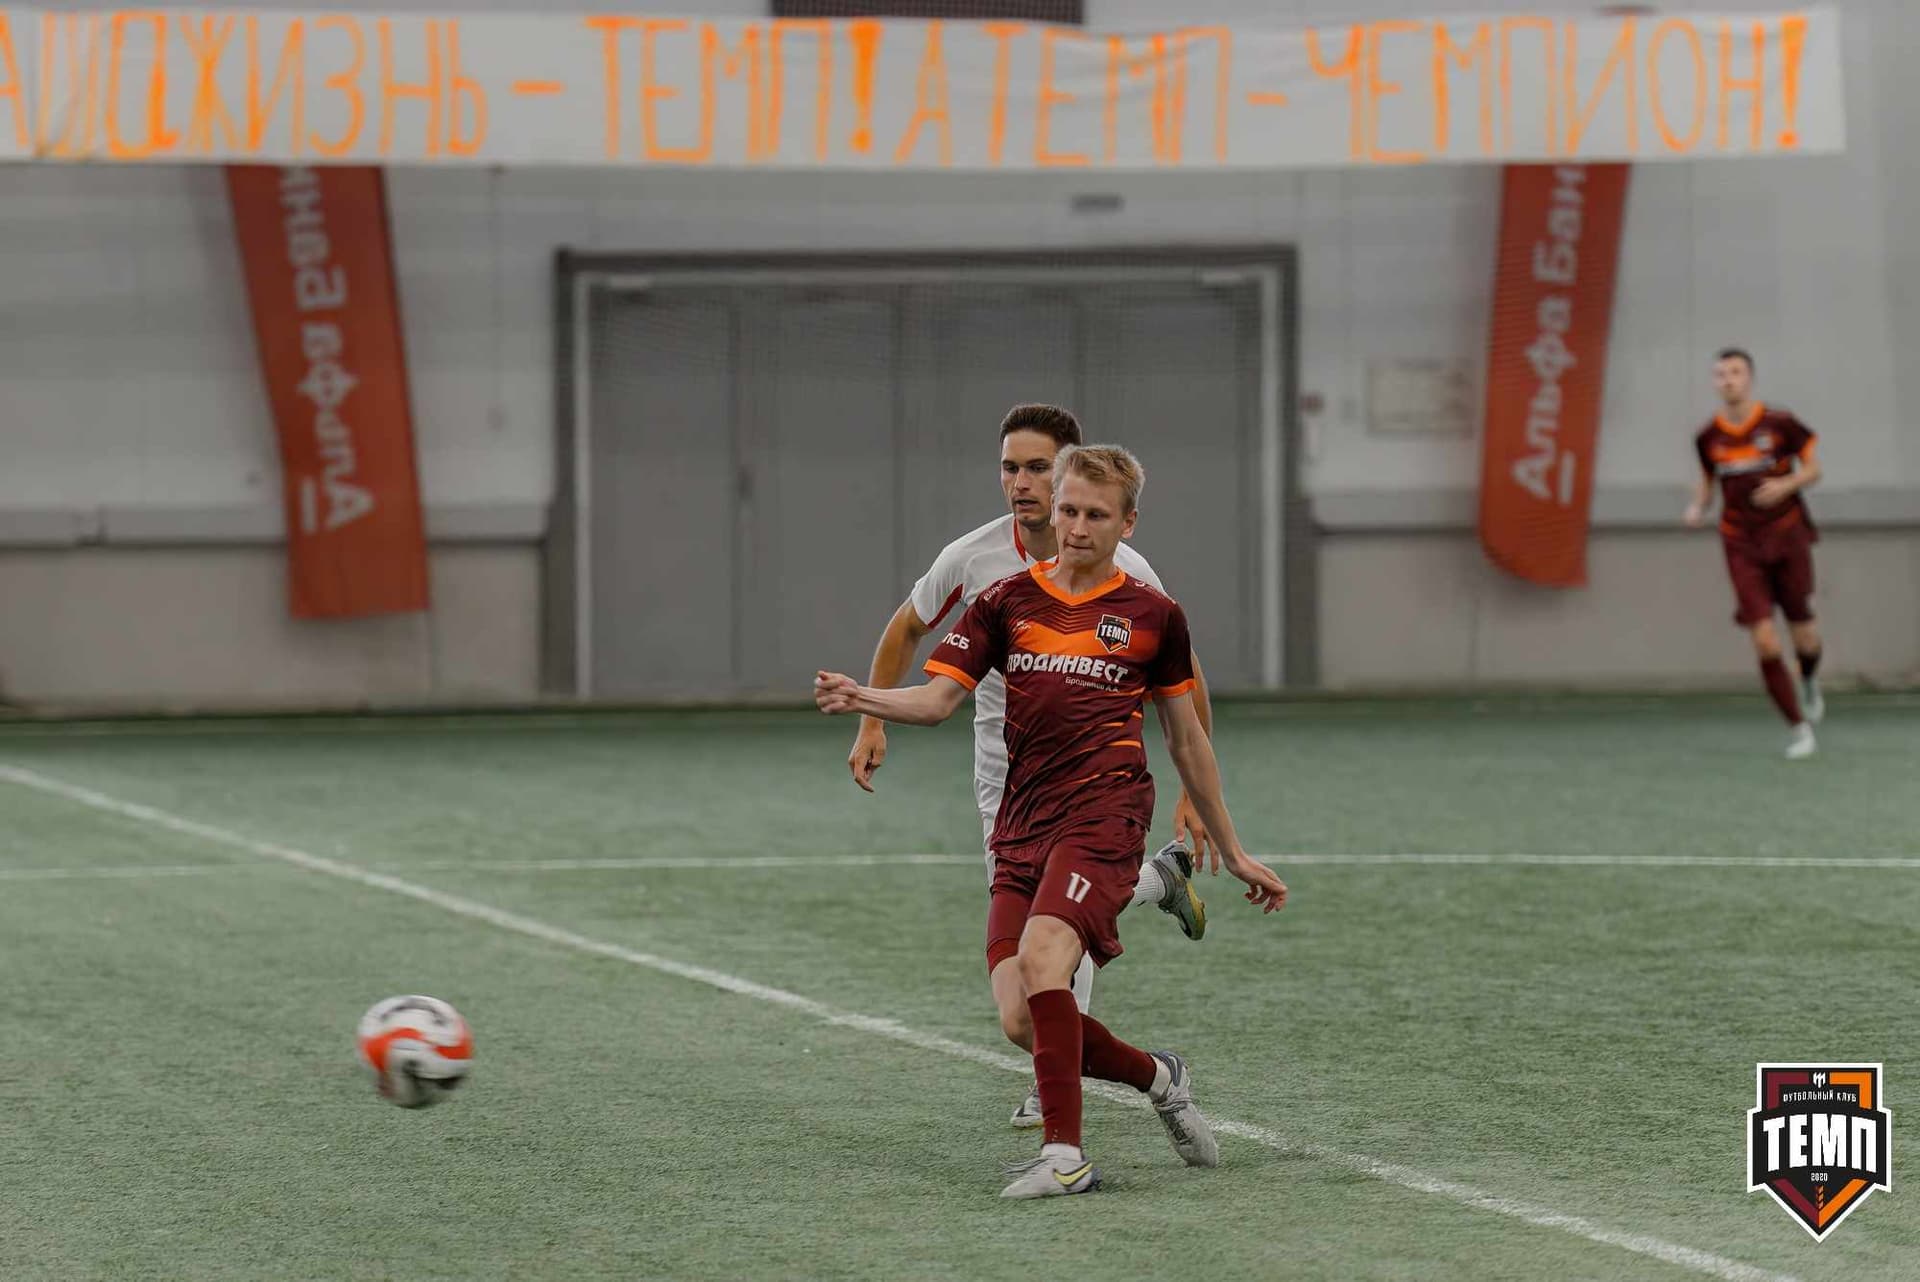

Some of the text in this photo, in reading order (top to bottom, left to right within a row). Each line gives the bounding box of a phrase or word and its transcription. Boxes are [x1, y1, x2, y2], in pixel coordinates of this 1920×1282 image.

[178, 14, 489, 157] ЖИЗНЬ
[583, 14, 884, 163] ТЕМП!
[984, 22, 1230, 167] ТЕМП
[1304, 16, 1808, 163] ЧЕМПИОН!
[1512, 295, 1578, 508] Альфа
[1100, 624, 1129, 644] ТЕМП
[1006, 653, 1129, 683] ПРОДИНВЕСТ
[1065, 872, 1092, 904] 17
